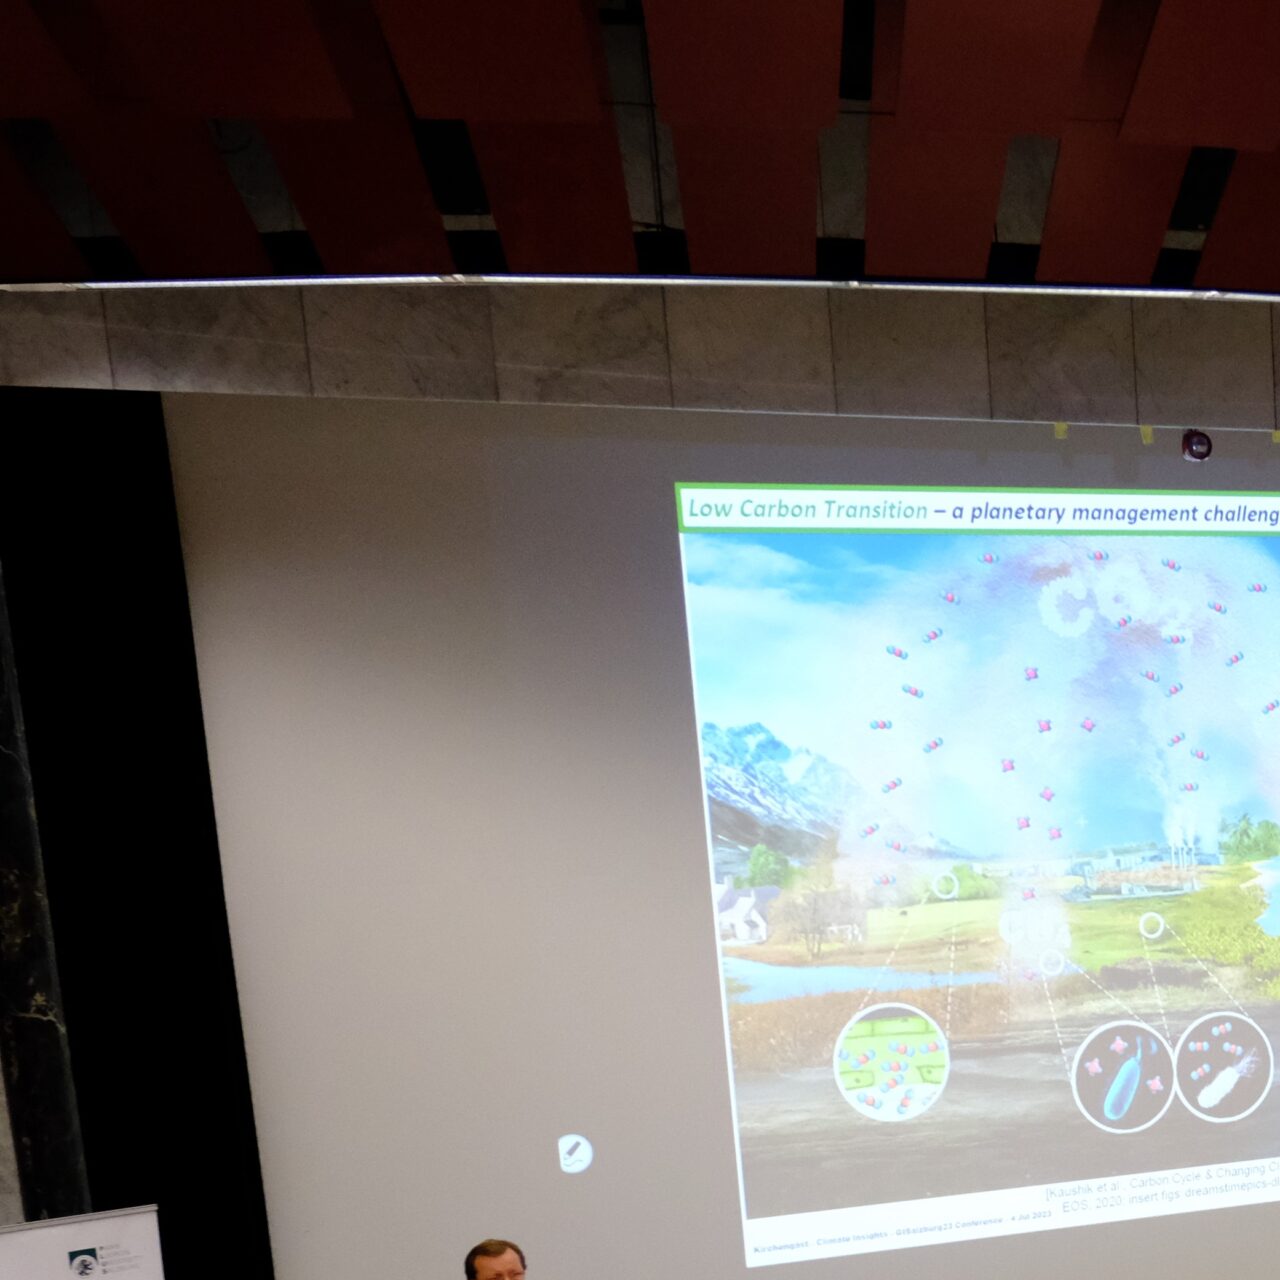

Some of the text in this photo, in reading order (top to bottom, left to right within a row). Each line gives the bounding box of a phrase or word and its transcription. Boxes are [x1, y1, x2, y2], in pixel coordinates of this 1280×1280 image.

[688, 498, 732, 518] Low
[739, 498, 817, 518] Carbon
[824, 499, 928, 519] Transition
[952, 506, 964, 520] a
[970, 501, 1066, 524] planetary
[1072, 504, 1199, 525] management
[1129, 1176, 1169, 1189] Carbon
